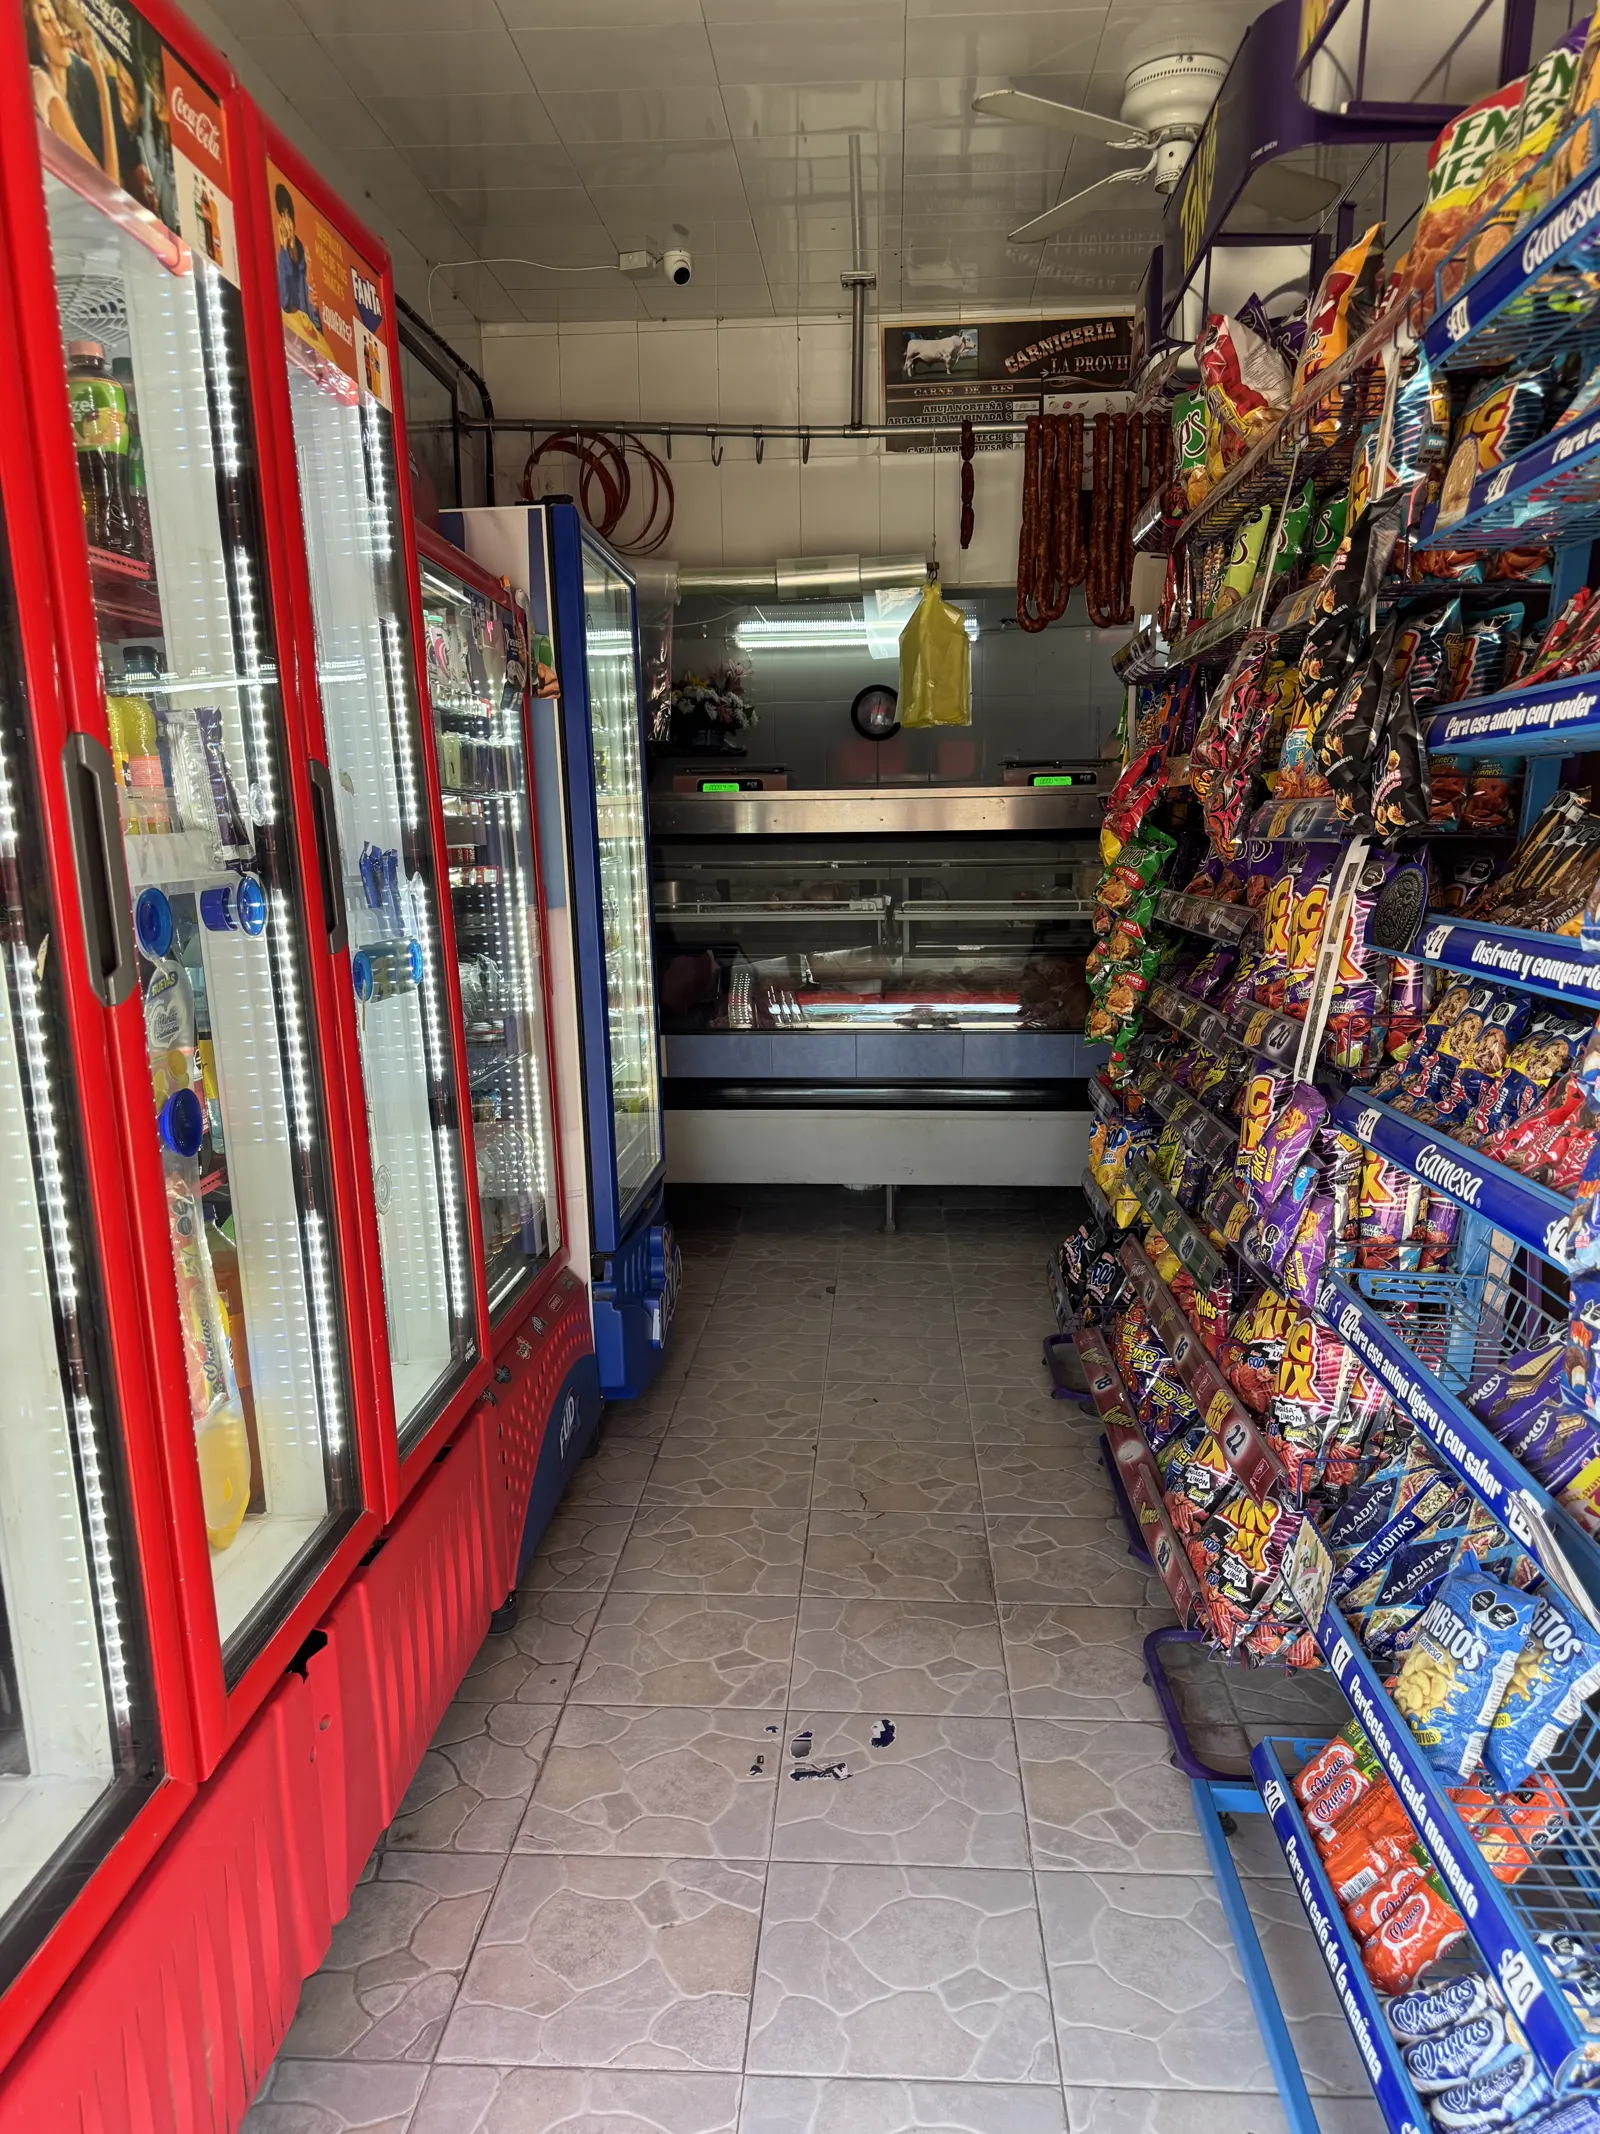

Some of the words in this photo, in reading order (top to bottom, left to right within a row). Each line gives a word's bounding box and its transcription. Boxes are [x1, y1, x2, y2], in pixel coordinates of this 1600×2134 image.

[351, 266, 382, 317] FANTA
[1004, 321, 1117, 374] CARNICERIA
[1050, 357, 1070, 374] LA
[914, 387, 954, 397] CARNE
[964, 386, 981, 395] DE
[991, 384, 1014, 394] RES
[923, 404, 954, 414] AHUJA
[955, 401, 1003, 411] NORTEÑA
[887, 415, 948, 425] ARRACHERA
[949, 412, 1003, 422] MARINADA
[1445, 716, 1469, 739] Para
[1470, 715, 1489, 734] ese
[1489, 703, 1525, 734] antojo
[1526, 699, 1553, 725] con
[1550, 692, 1598, 729] poder
[1471, 939, 1523, 972] Disfruta
[1519, 955, 1532, 980] y
[151, 972, 176, 997] NUEVAS
[1415, 1143, 1484, 1206] Gamesa
[1174, 1337, 1188, 1361] 16
[1206, 1409, 1224, 1432] MIX
[1212, 1391, 1233, 1411] BIG
[1367, 1345, 1382, 1366] ese
[1381, 1358, 1409, 1400] antojo
[1407, 1381, 1438, 1429] ligero
[1435, 1423, 1447, 1444] y
[1444, 1428, 1467, 1462] con
[1464, 1449, 1502, 1500] sabor
[559, 1394, 577, 1461] FUD
[1225, 1424, 1247, 1456] 22
[1331, 1483, 1393, 1545] SALADITAS
[1360, 1516, 1416, 1573] SALADITAS
[1382, 1542, 1452, 1604] SALADITAS
[1418, 1632, 1443, 1664] Gamesa
[1310, 1754, 1345, 1797] Marias
[1350, 1674, 1391, 1762] Perfectas
[1388, 1752, 1404, 1782] en
[1400, 1779, 1427, 1827] cada
[1422, 1816, 1479, 1919] momento
[1315, 1777, 1352, 1821] Marias
[1389, 1903, 1422, 1940] Marias
[1285, 1836, 1304, 1886] Para
[1300, 1878, 1313, 1905] tu
[1307, 1902, 1334, 1948] café
[1325, 1941, 1340, 1974] de
[1335, 1965, 1350, 1994] la
[1345, 1992, 1383, 2084] mañana
[1392, 1979, 1473, 2035] Marias
[1408, 2017, 1491, 2081] Marias
